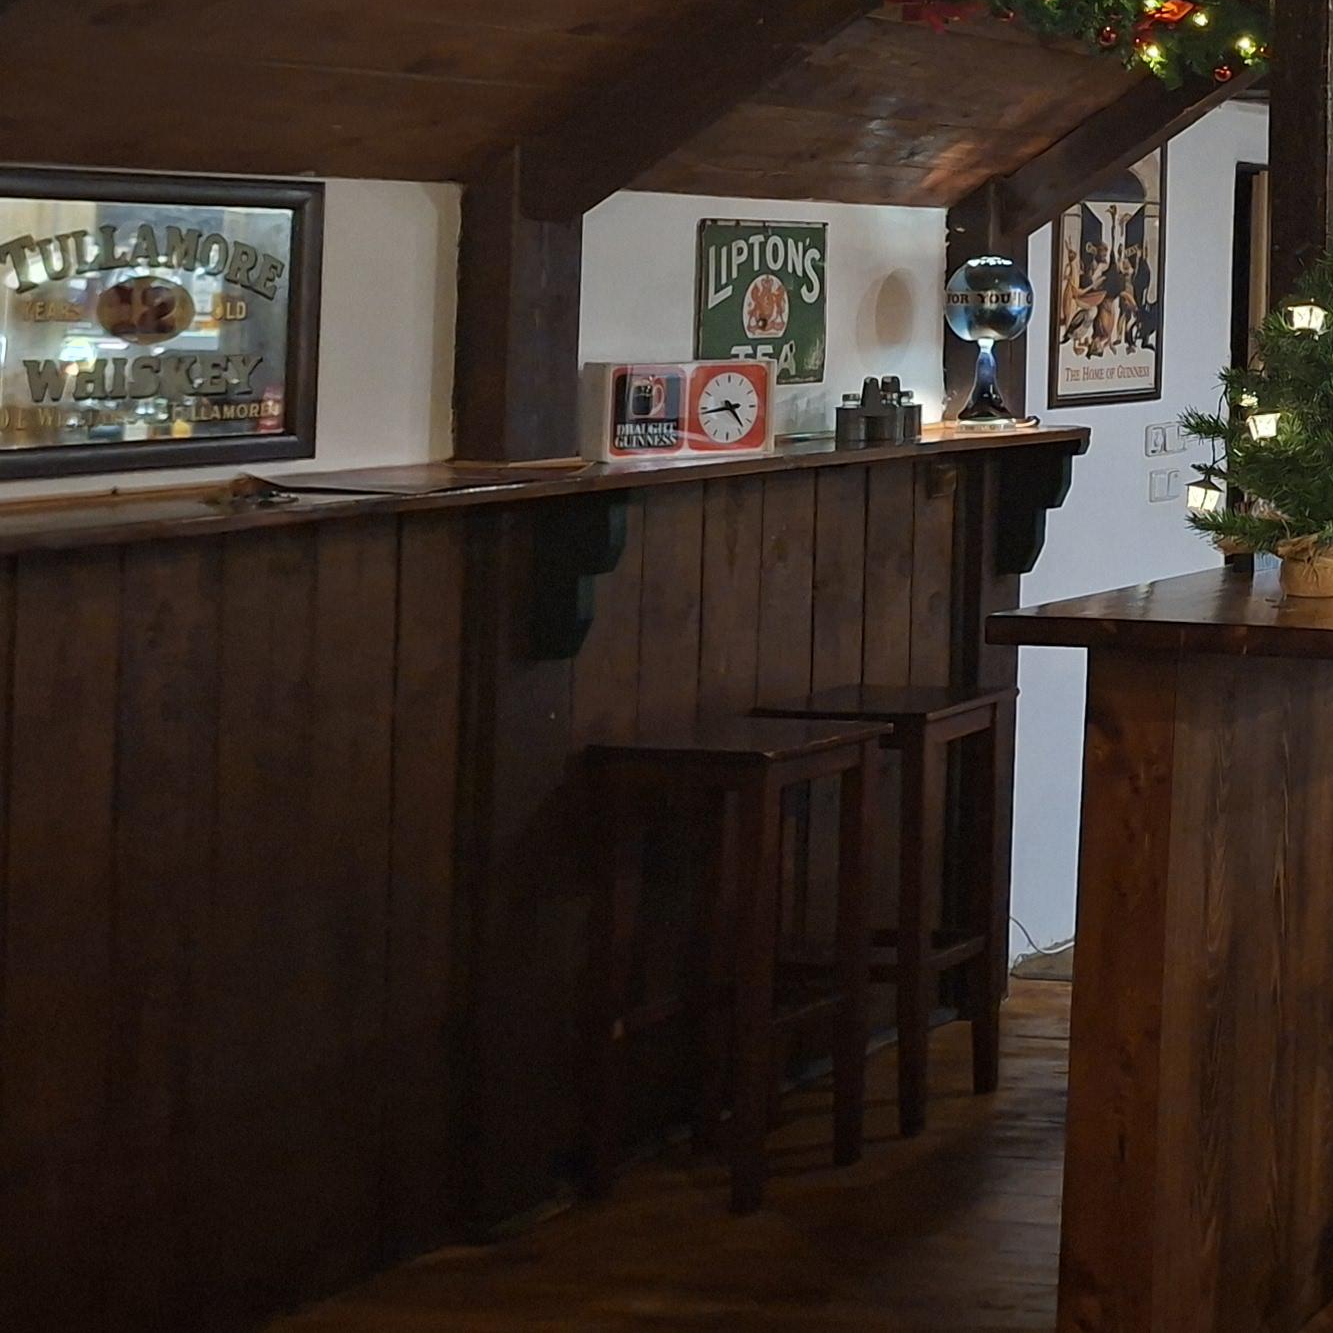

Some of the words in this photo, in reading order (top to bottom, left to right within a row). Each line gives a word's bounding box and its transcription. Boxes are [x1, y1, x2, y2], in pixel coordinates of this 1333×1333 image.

[0, 223, 286, 302] TULLAMORE
[707, 234, 821, 310] LIPTON'S
[977, 292, 1011, 305] YOU
[23, 354, 263, 403] WHISKEY
[614, 433, 677, 448] GUINNESS
